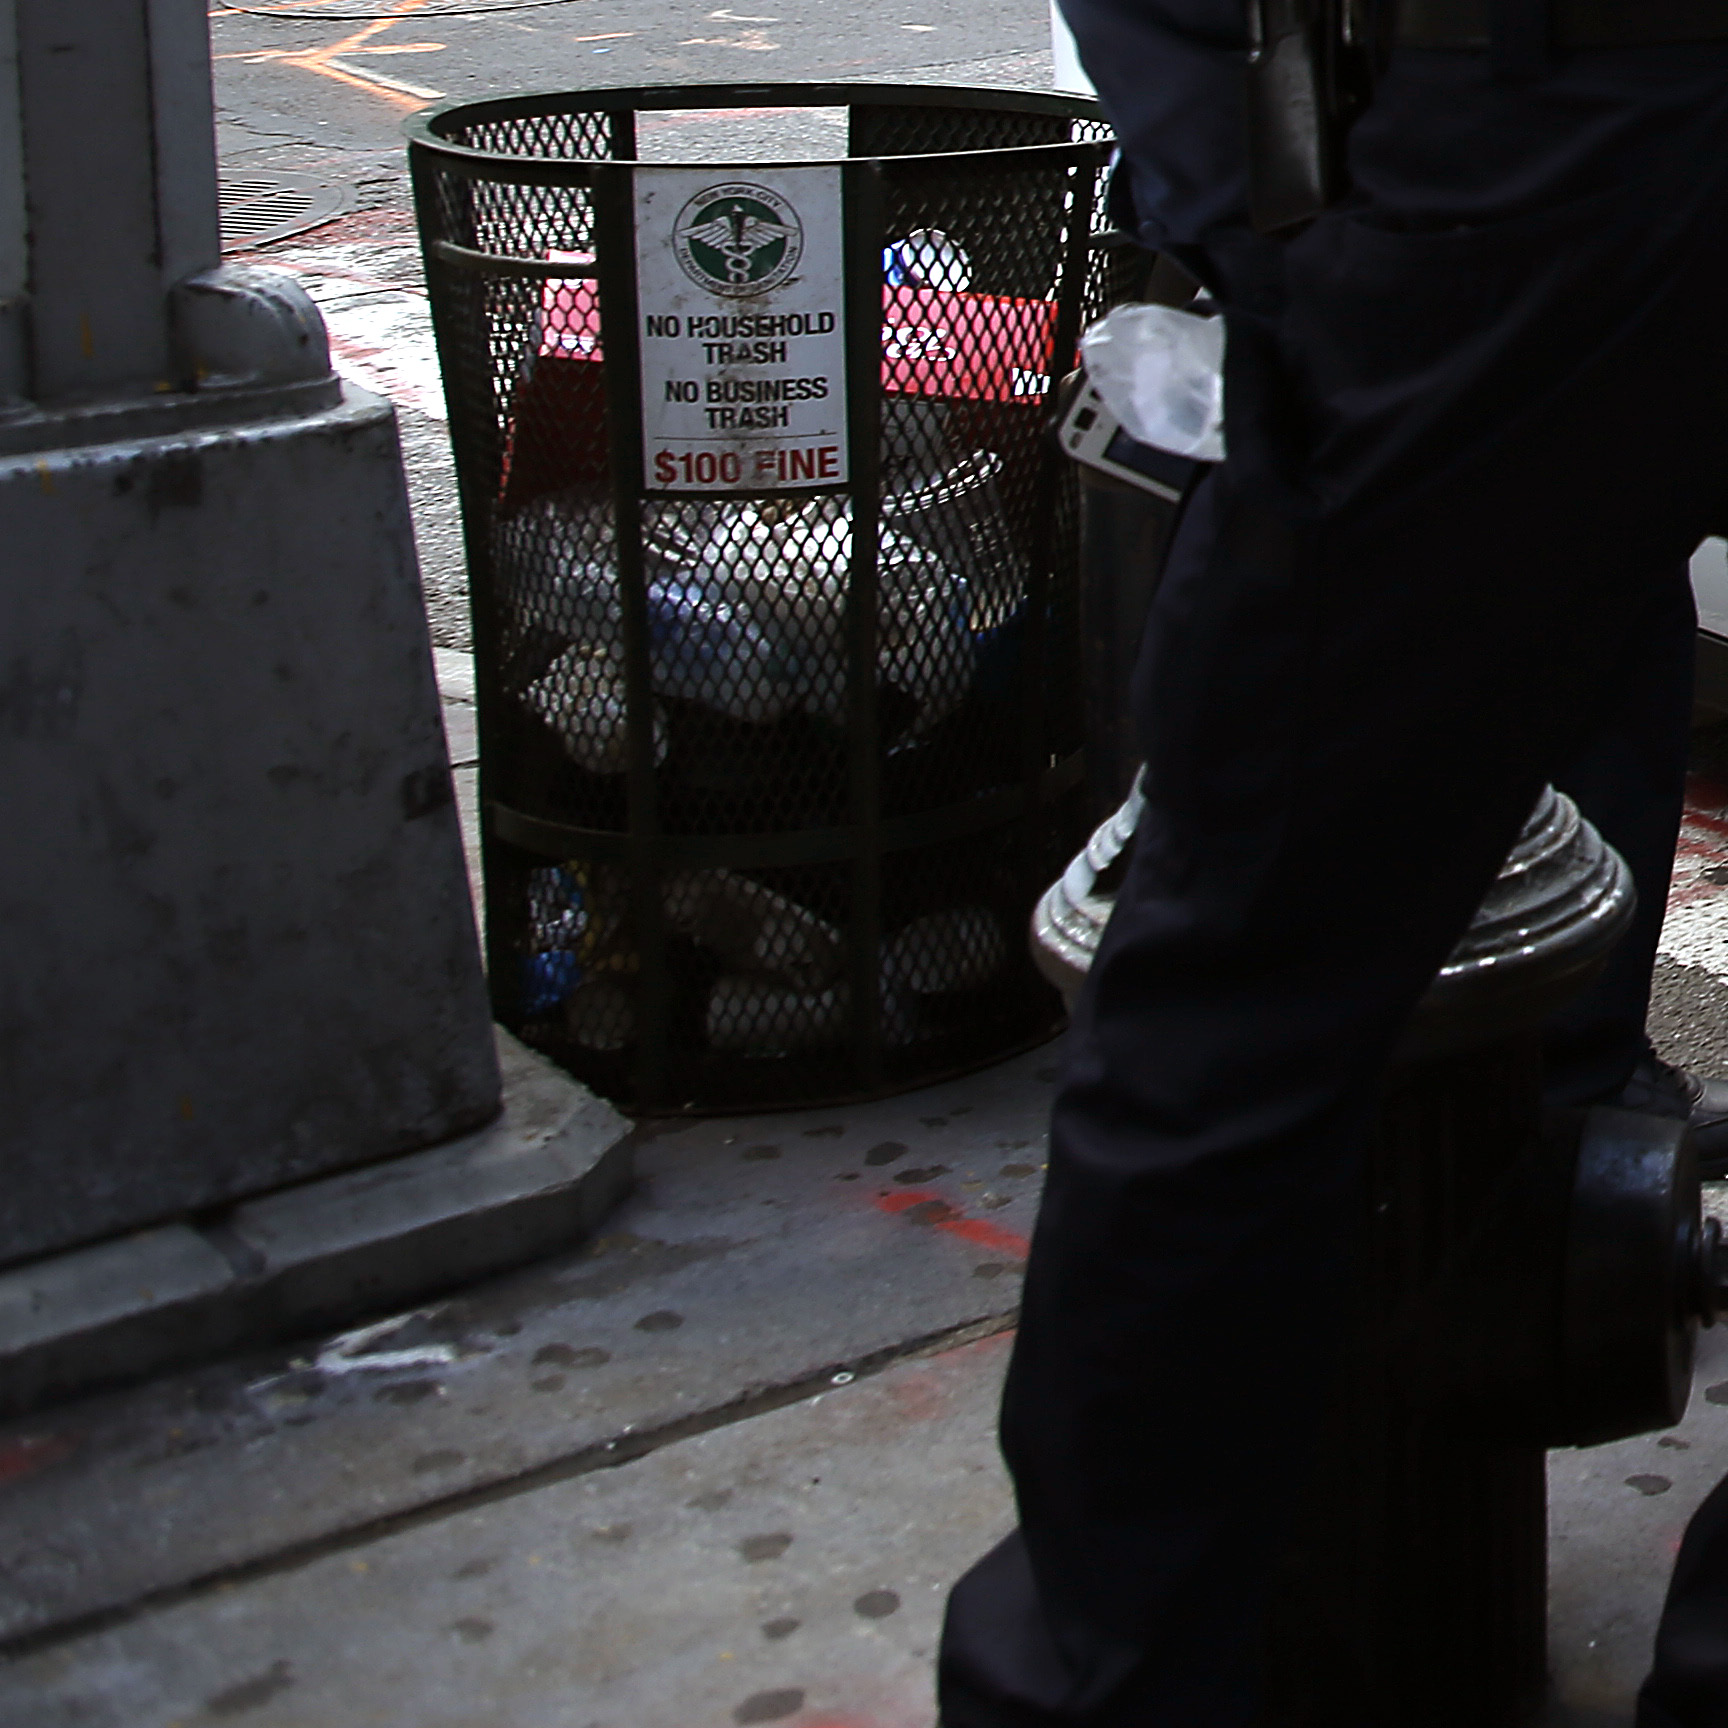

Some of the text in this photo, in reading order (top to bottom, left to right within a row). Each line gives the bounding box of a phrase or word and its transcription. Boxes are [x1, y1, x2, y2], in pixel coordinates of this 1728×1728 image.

[646, 311, 836, 339] NO HOUSEHOLD
[702, 340, 787, 365] TRASH
[665, 375, 829, 404] NO BUSINESS
[704, 405, 790, 430] TRASH
[653, 445, 840, 484] $100 FINE
